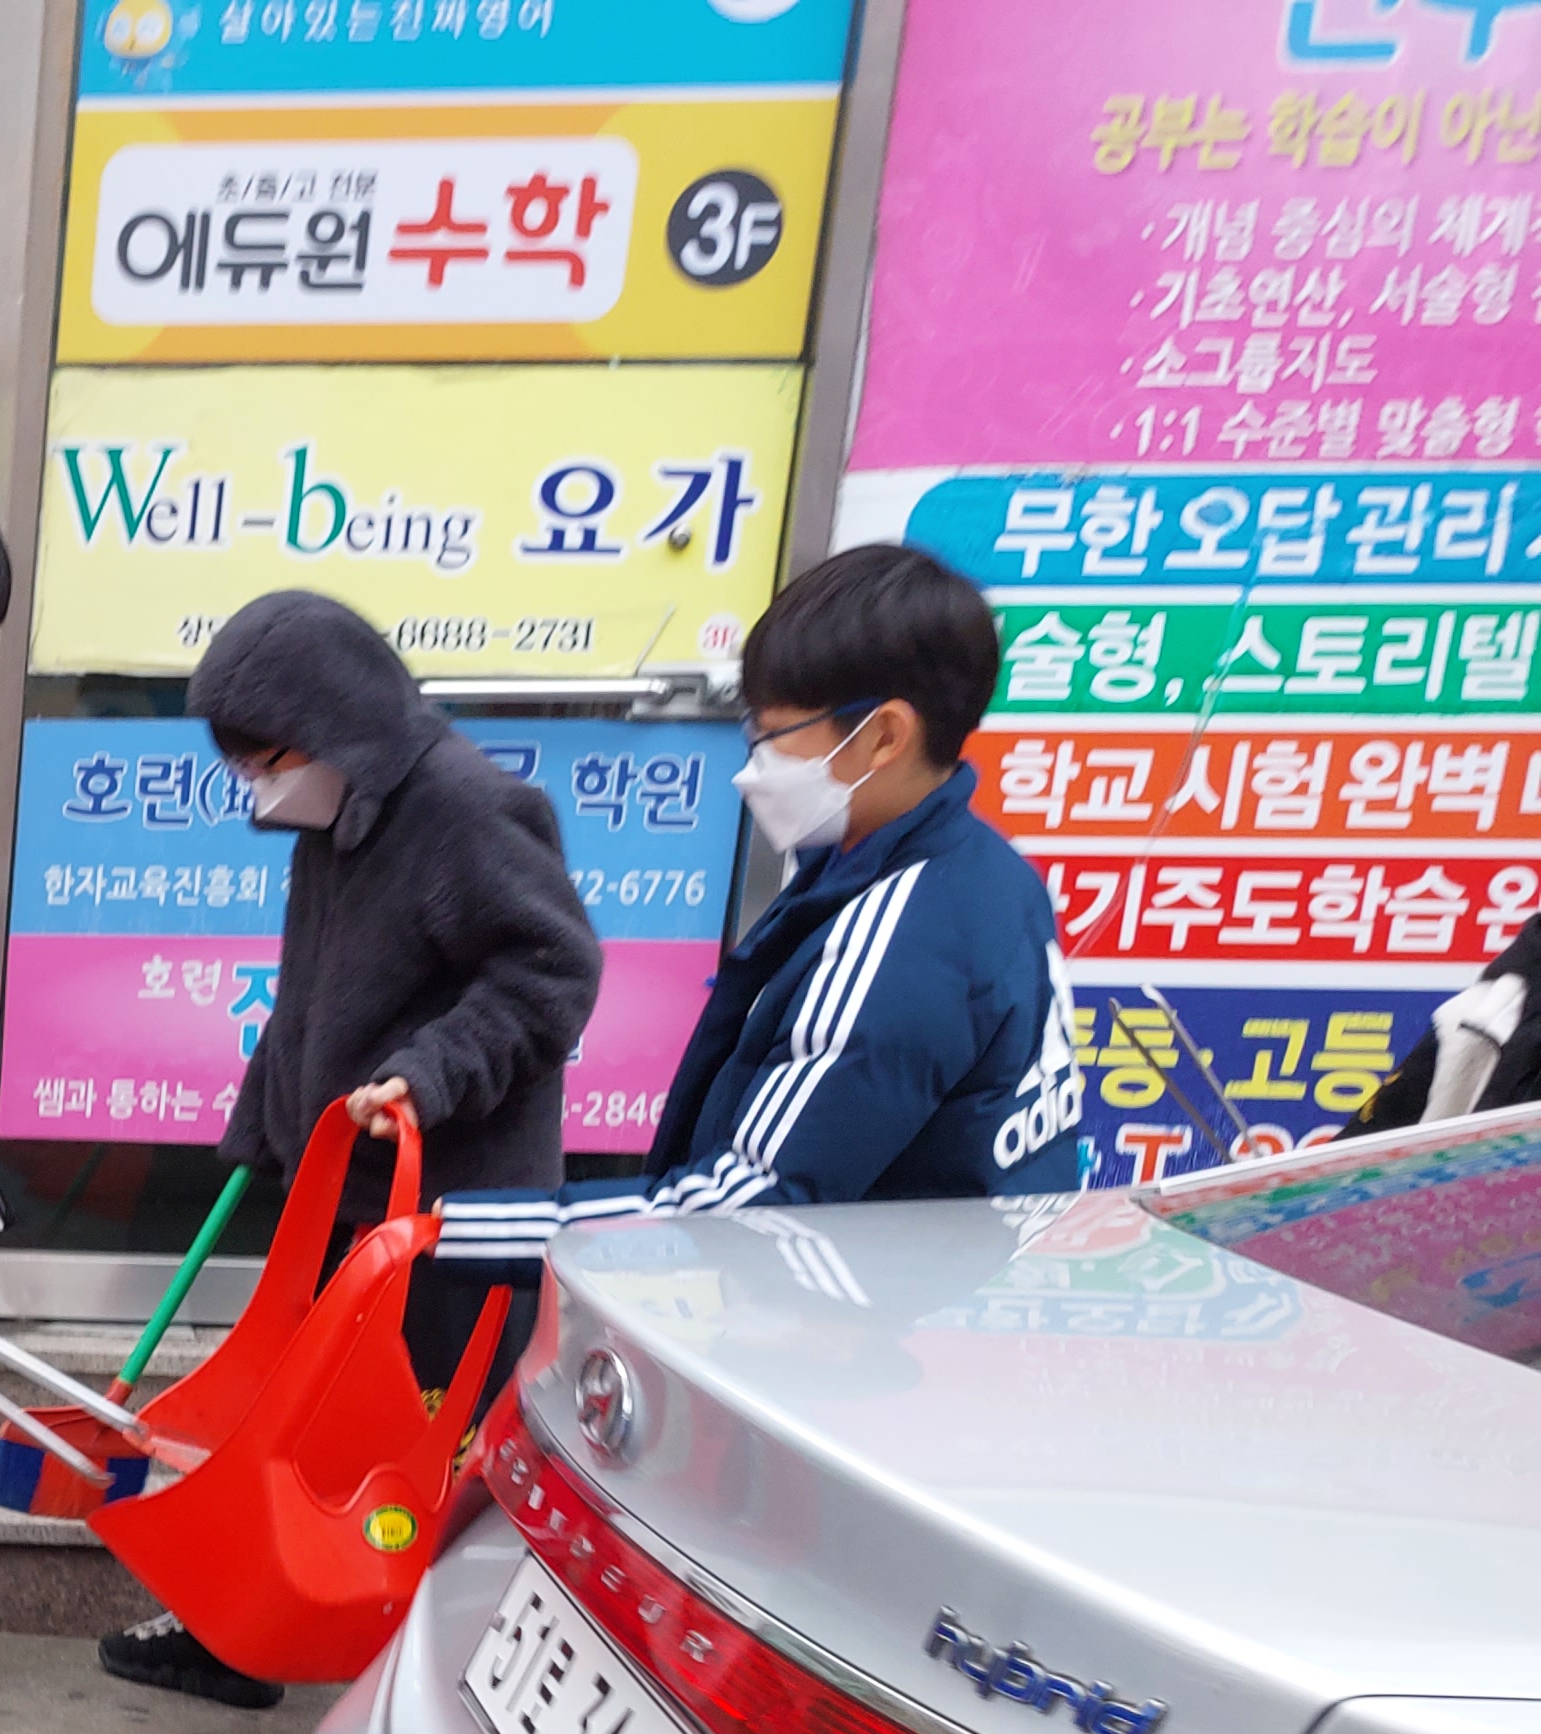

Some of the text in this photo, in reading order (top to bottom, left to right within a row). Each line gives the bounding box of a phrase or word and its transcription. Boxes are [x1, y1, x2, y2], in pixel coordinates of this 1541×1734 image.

[1091, 92, 1255, 175] 공부는
[1268, 88, 1428, 170] 학습이
[116, 171, 783, 293] 에듀원 수학 3F
[1427, 192, 1541, 260] 체계
[1135, 331, 1380, 395] 소그룹지도
[1217, 398, 1365, 460] 수준별
[1376, 395, 1521, 459] 맞춤형
[520, 455, 757, 567] 요가
[993, 480, 1164, 579] 무한
[1345, 480, 1516, 578] 관리
[997, 608, 1186, 707] 술형,
[573, 751, 707, 832] 학원
[999, 738, 1155, 830] 학교
[1165, 740, 1332, 831] 시험
[1338, 738, 1511, 832] 완벽
